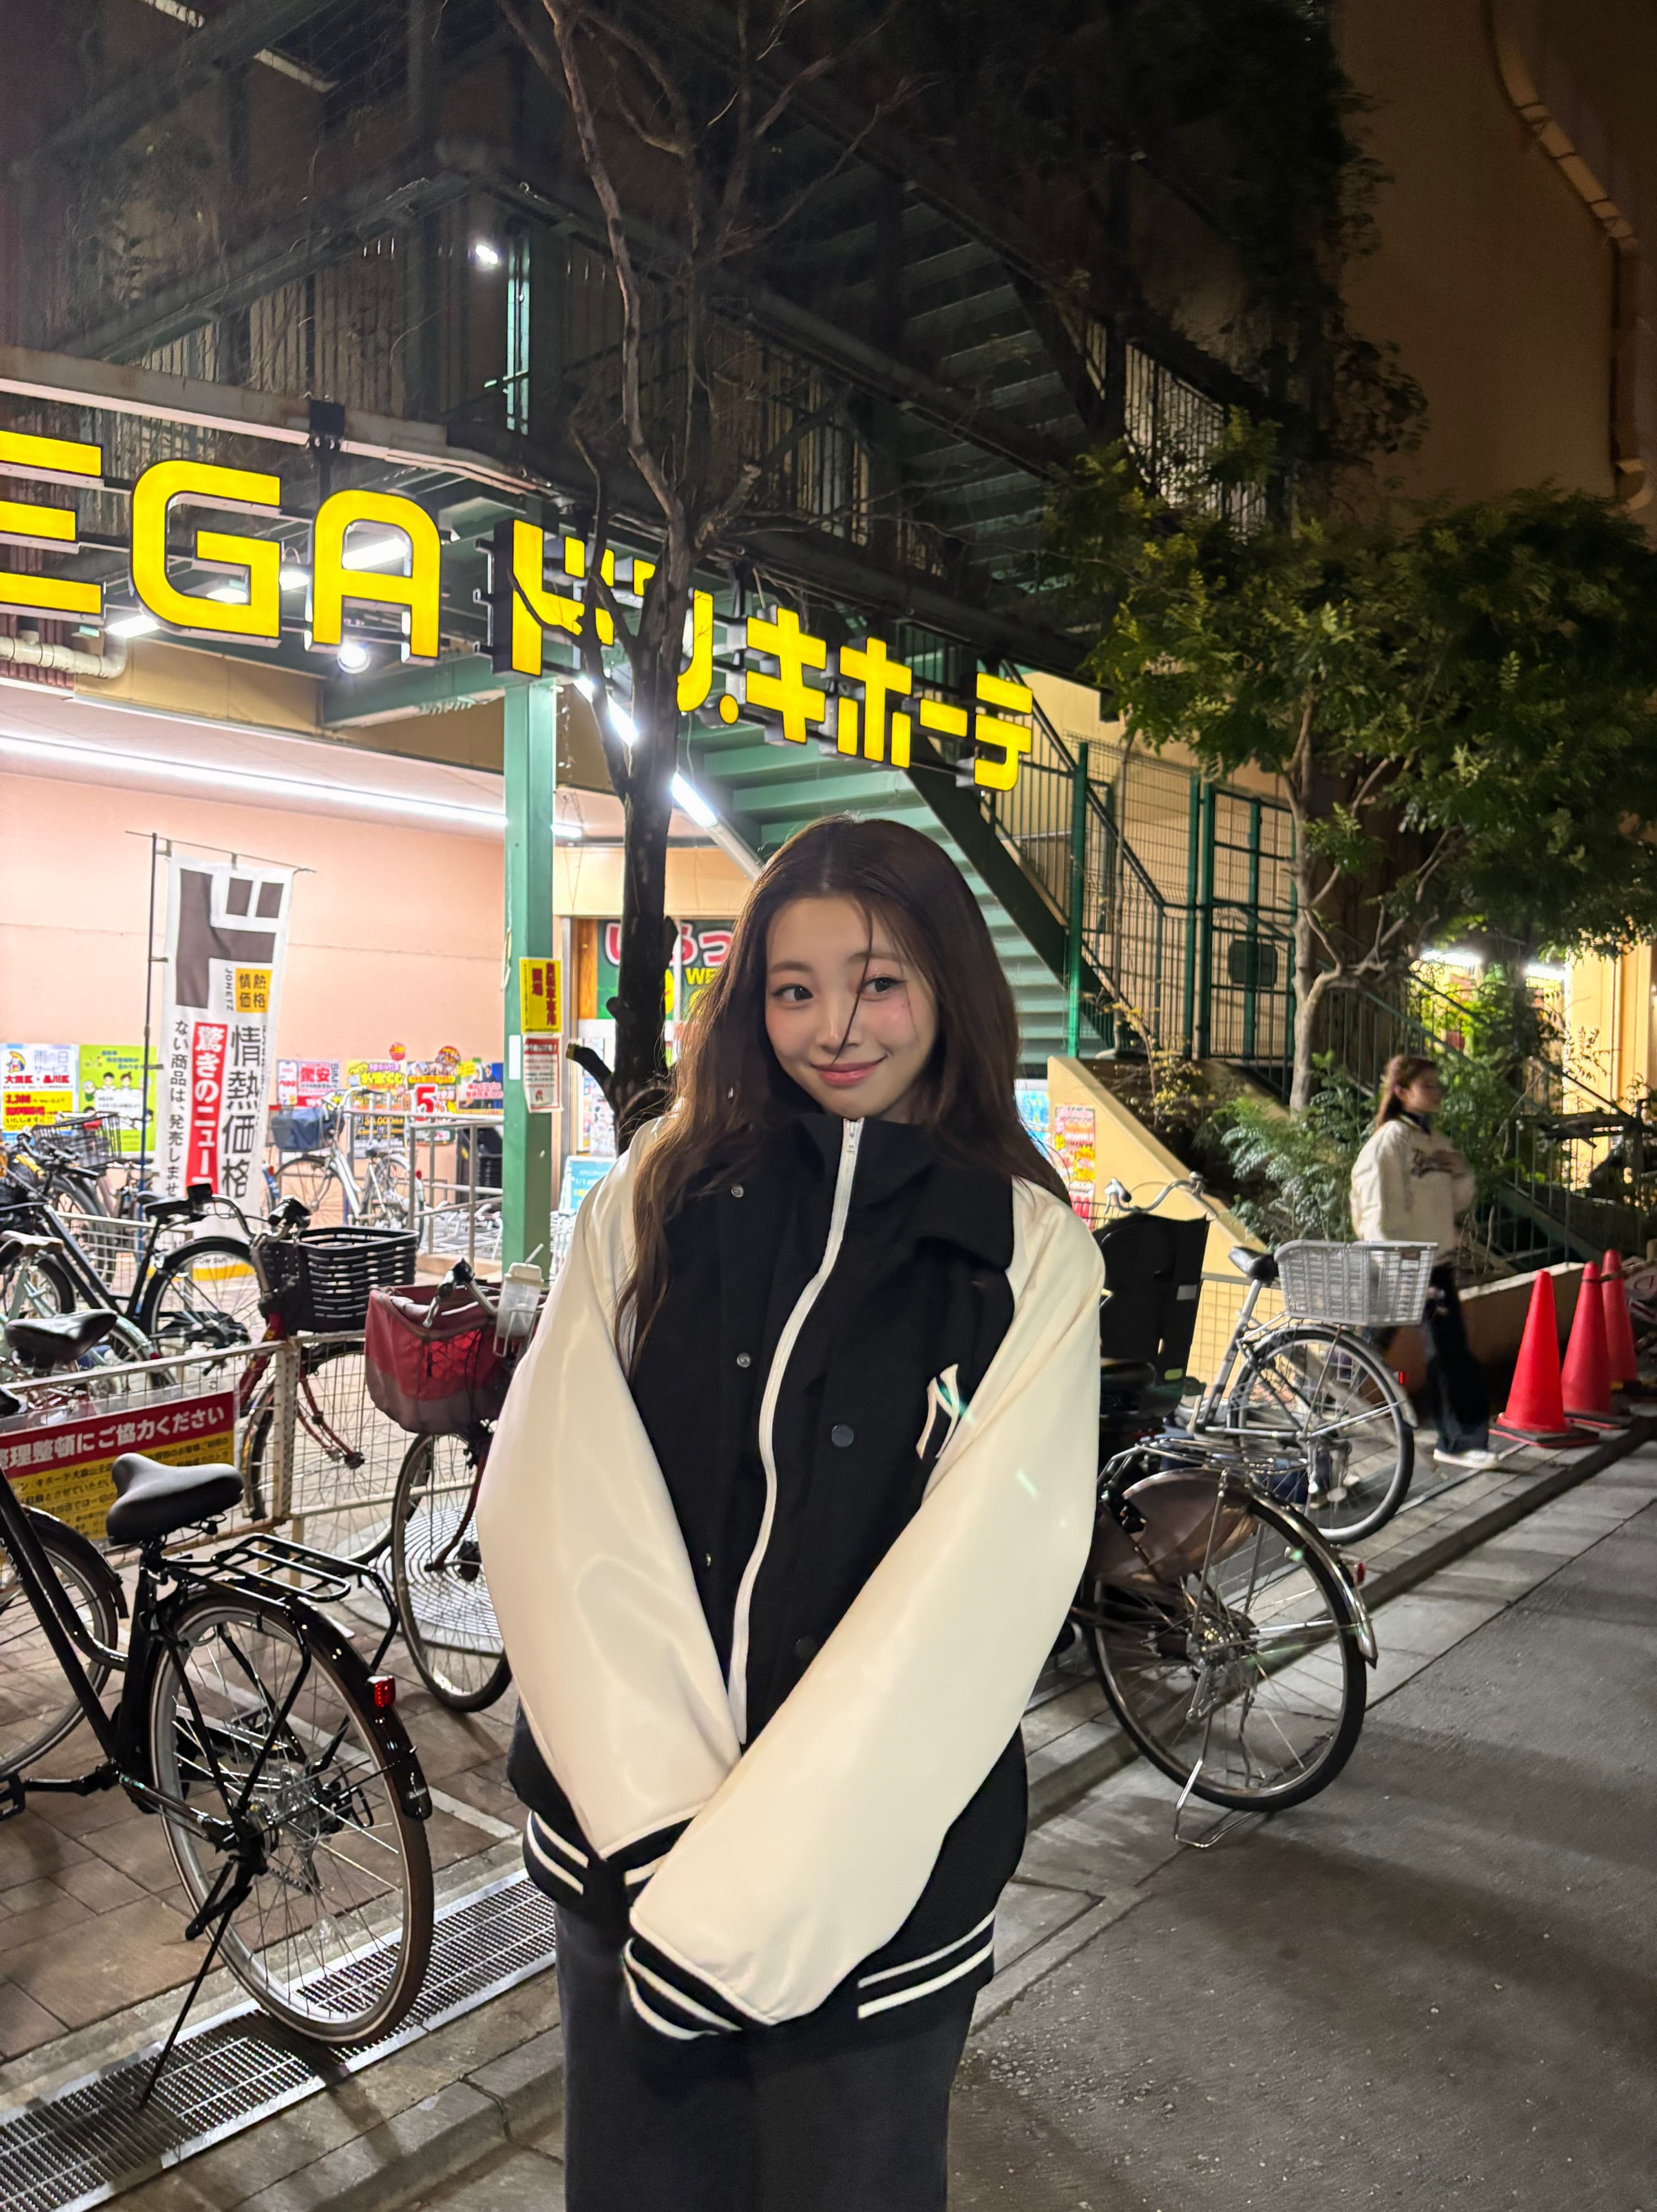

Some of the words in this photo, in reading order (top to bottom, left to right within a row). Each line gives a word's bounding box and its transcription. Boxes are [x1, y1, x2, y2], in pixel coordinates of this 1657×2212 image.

[176, 868, 285, 1009] ド
[221, 1024, 261, 1199] 情熱価格
